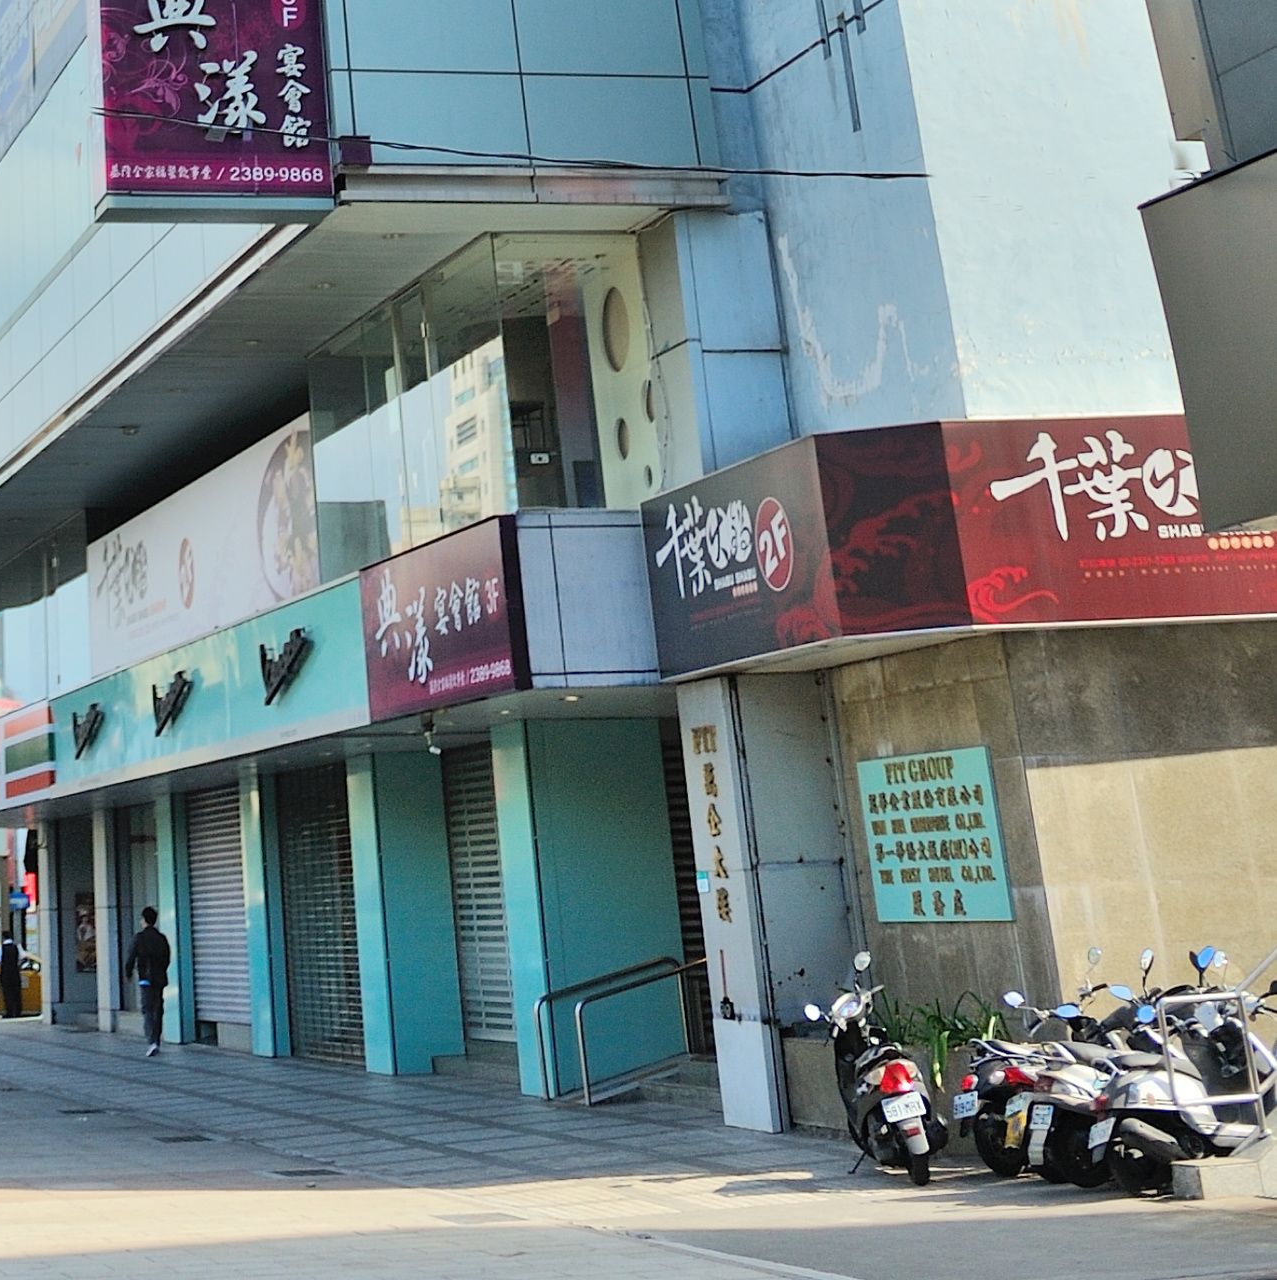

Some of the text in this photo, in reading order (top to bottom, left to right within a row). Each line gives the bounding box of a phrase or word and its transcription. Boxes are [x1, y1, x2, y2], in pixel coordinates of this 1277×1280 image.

[276, 43, 311, 149] 宴會館
[759, 510, 787, 578] 2F
[909, 756, 954, 783] GROUP
